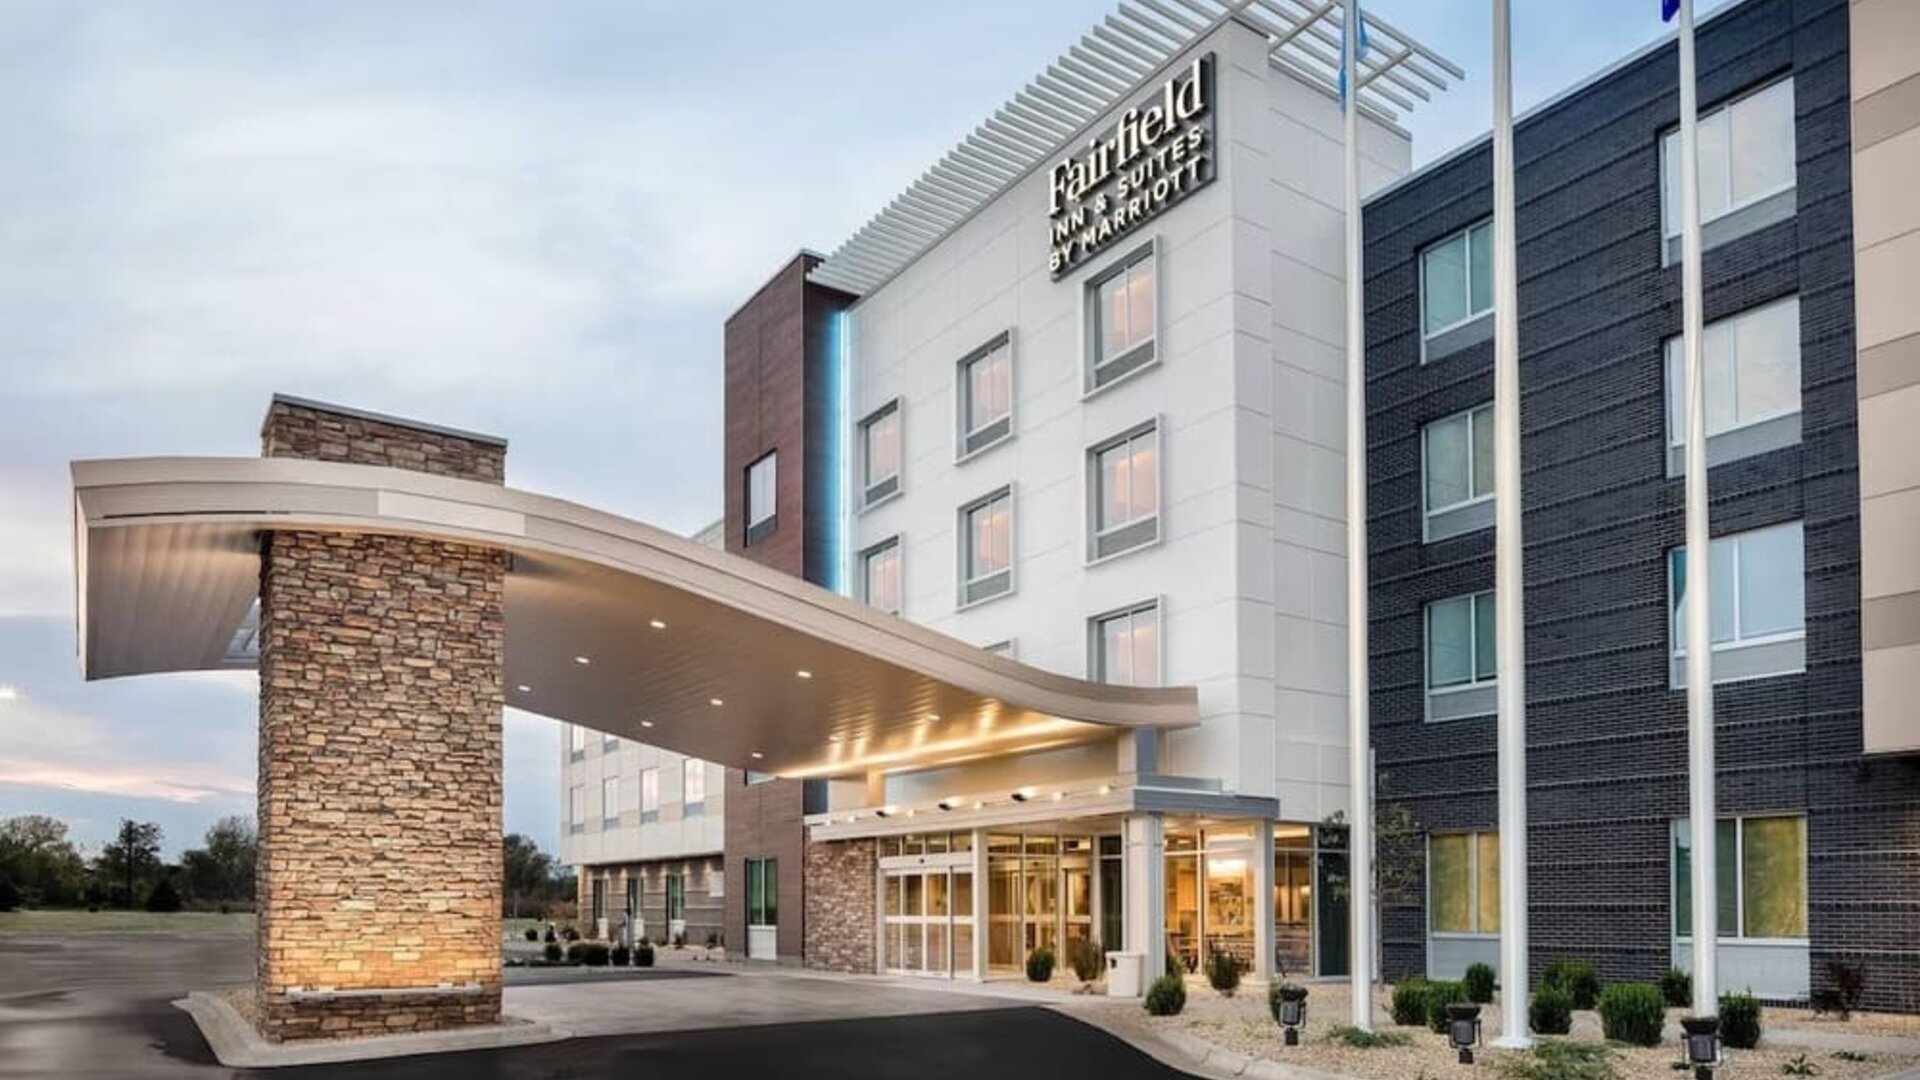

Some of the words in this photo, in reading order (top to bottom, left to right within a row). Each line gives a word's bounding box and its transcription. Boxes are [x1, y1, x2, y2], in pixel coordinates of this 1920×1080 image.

[1048, 57, 1205, 215] Fairfield
[1049, 208, 1084, 244] INN
[1094, 193, 1108, 214] &
[1117, 126, 1203, 199] SUITES
[1049, 242, 1073, 272] BY
[1081, 155, 1202, 252] MARRIOTT
